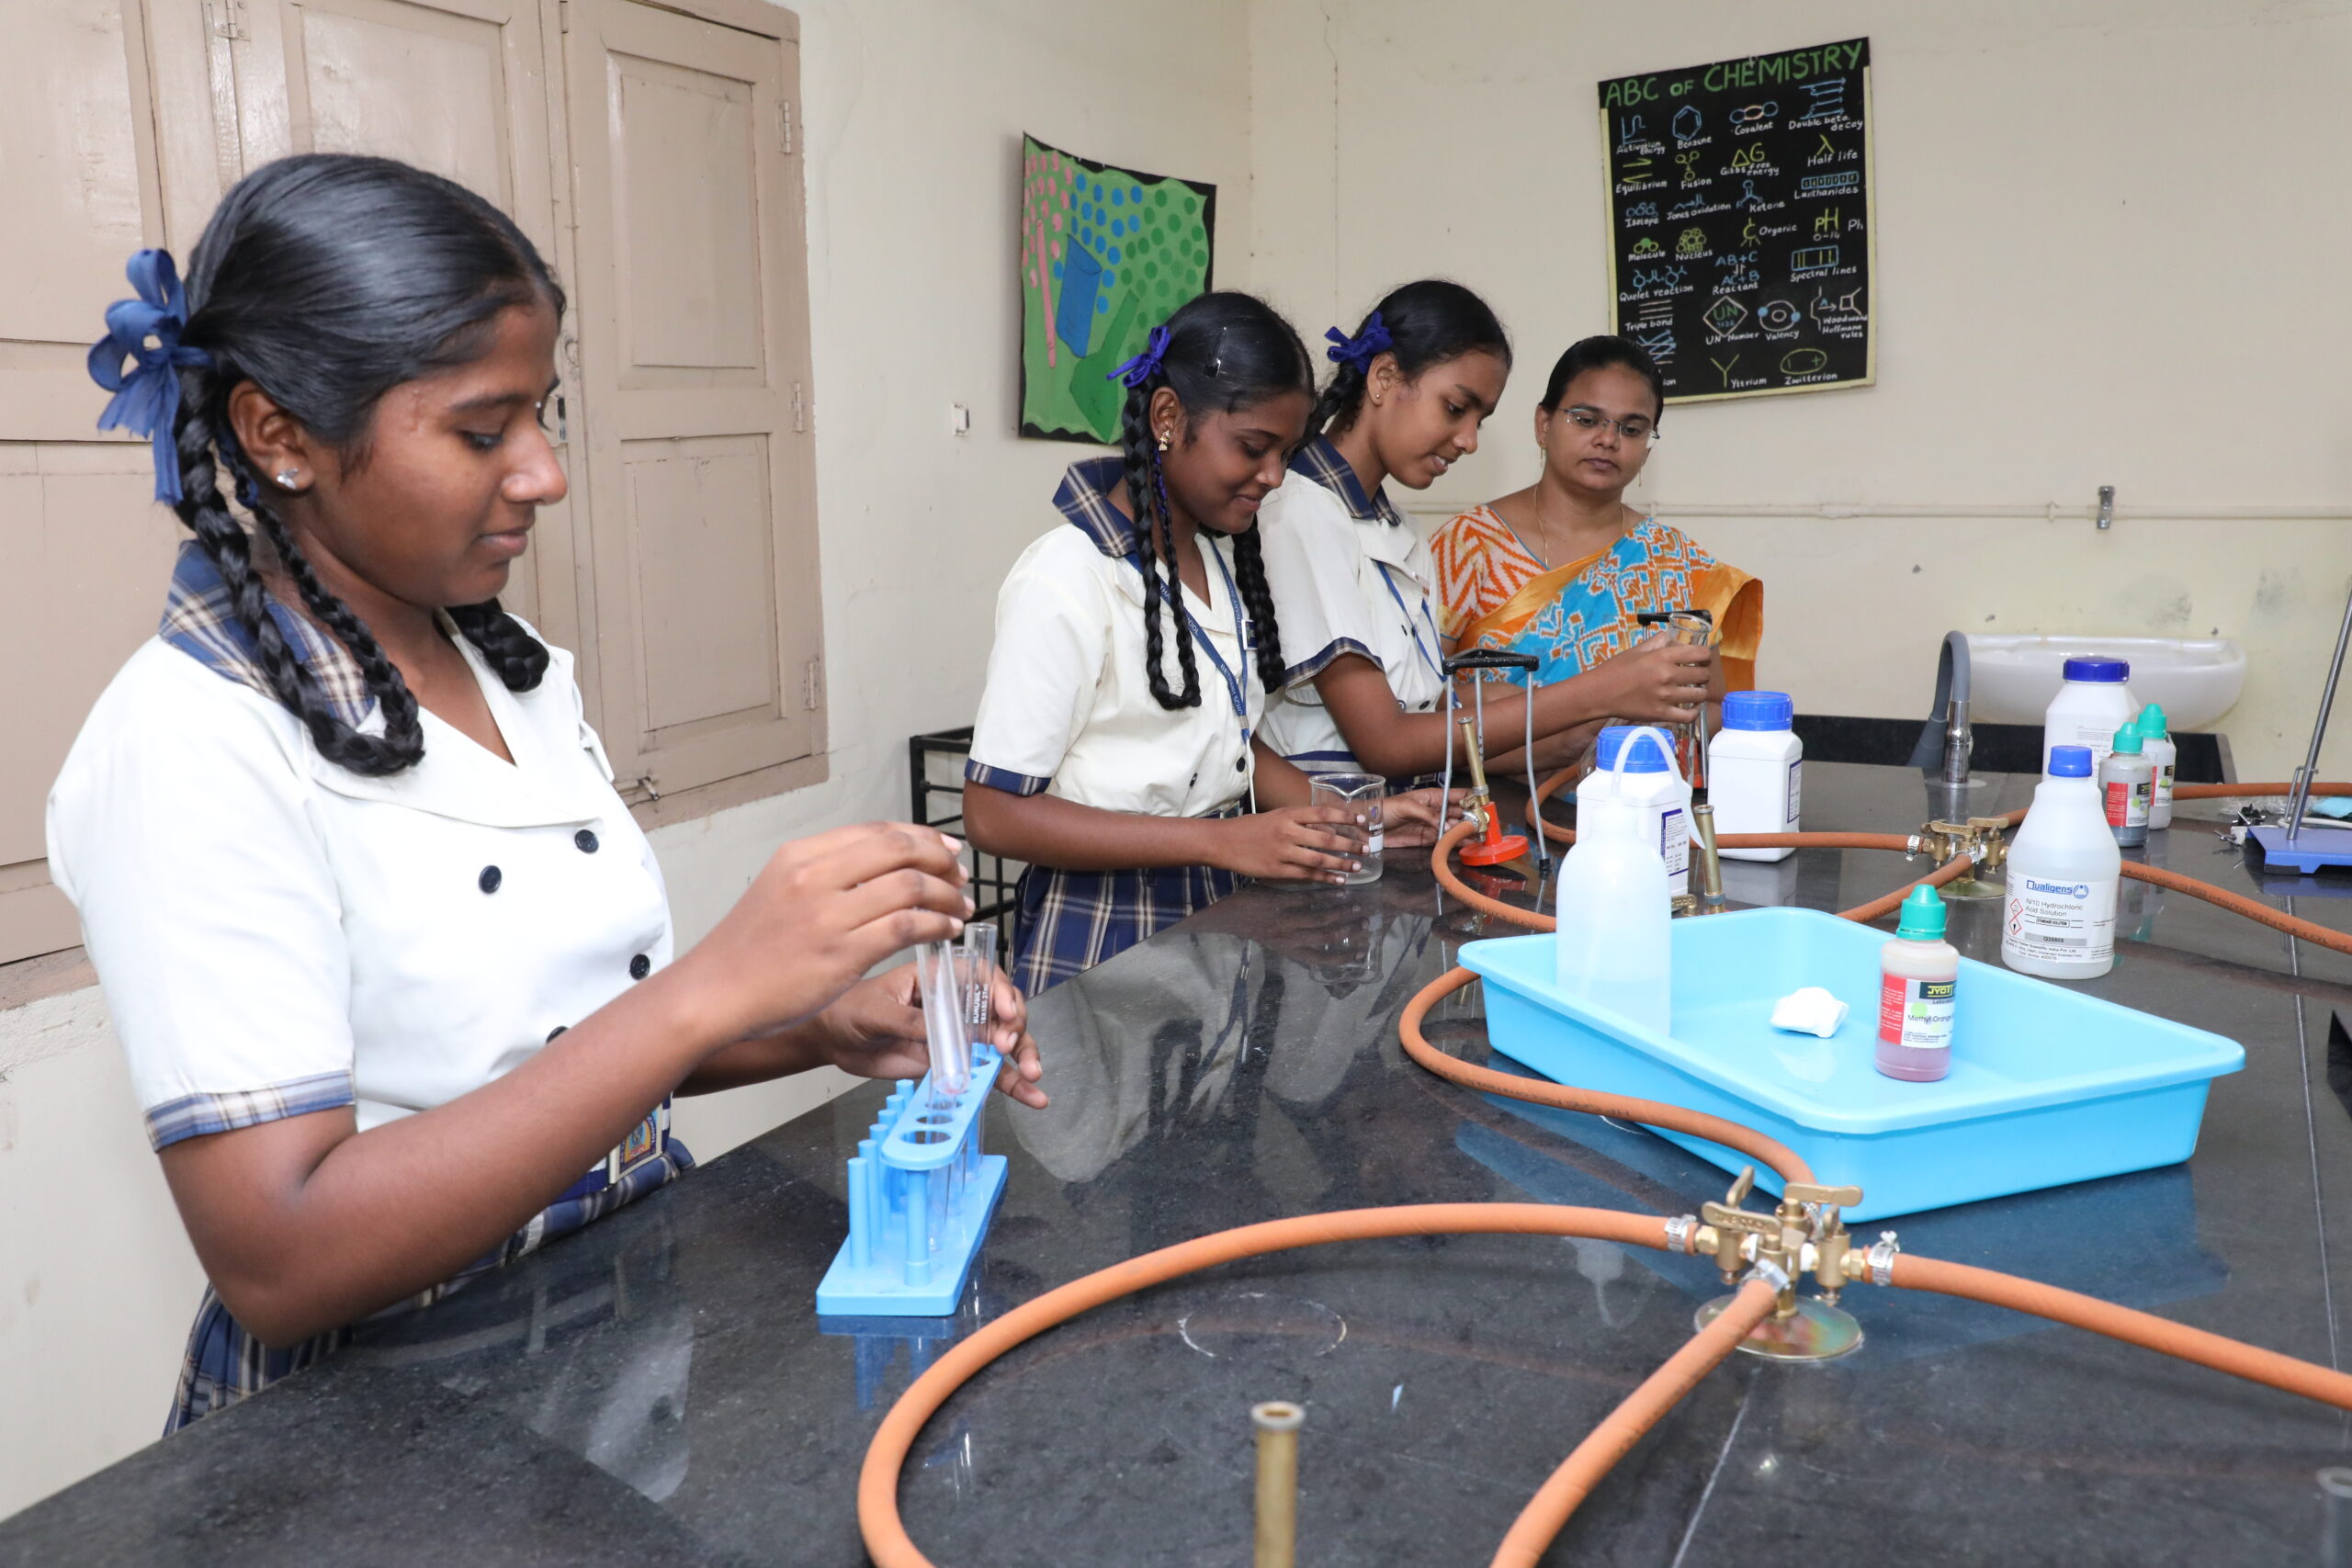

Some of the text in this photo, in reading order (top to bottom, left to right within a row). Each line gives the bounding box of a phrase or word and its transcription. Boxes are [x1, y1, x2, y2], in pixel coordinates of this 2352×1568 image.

[1605, 78, 1658, 107] ABC
[1704, 40, 1862, 92] CHEMISTRY
[1735, 121, 1773, 135] Covalent
[1788, 117, 1822, 130] Double
[1807, 150, 1859, 167] Half life
[1616, 180, 1668, 196] Equilibrium
[1680, 177, 1712, 189] Fusion
[1690, 203, 1731, 216] oxidation
[1749, 201, 1785, 213] Ketone
[1625, 218, 1659, 228] Isotope
[1758, 224, 1798, 236] Organic
[1628, 250, 1666, 262] Molecule
[1675, 249, 1713, 261] Nucleus
[1791, 265, 1858, 283] Spectral lines
[1654, 285, 1693, 297] reaction
[1713, 282, 1759, 295] Reactant
[1624, 318, 1673, 332] Triple bond
[1705, 333, 1759, 345] UN Number
[1765, 330, 1799, 341] Valency
[1840, 332, 1863, 340] rules
[1731, 378, 1767, 389] Yttrium
[1784, 373, 1838, 385] Zwitterion
[2026, 879, 2073, 896] Qualigens
[2040, 908, 2067, 917] Solution
